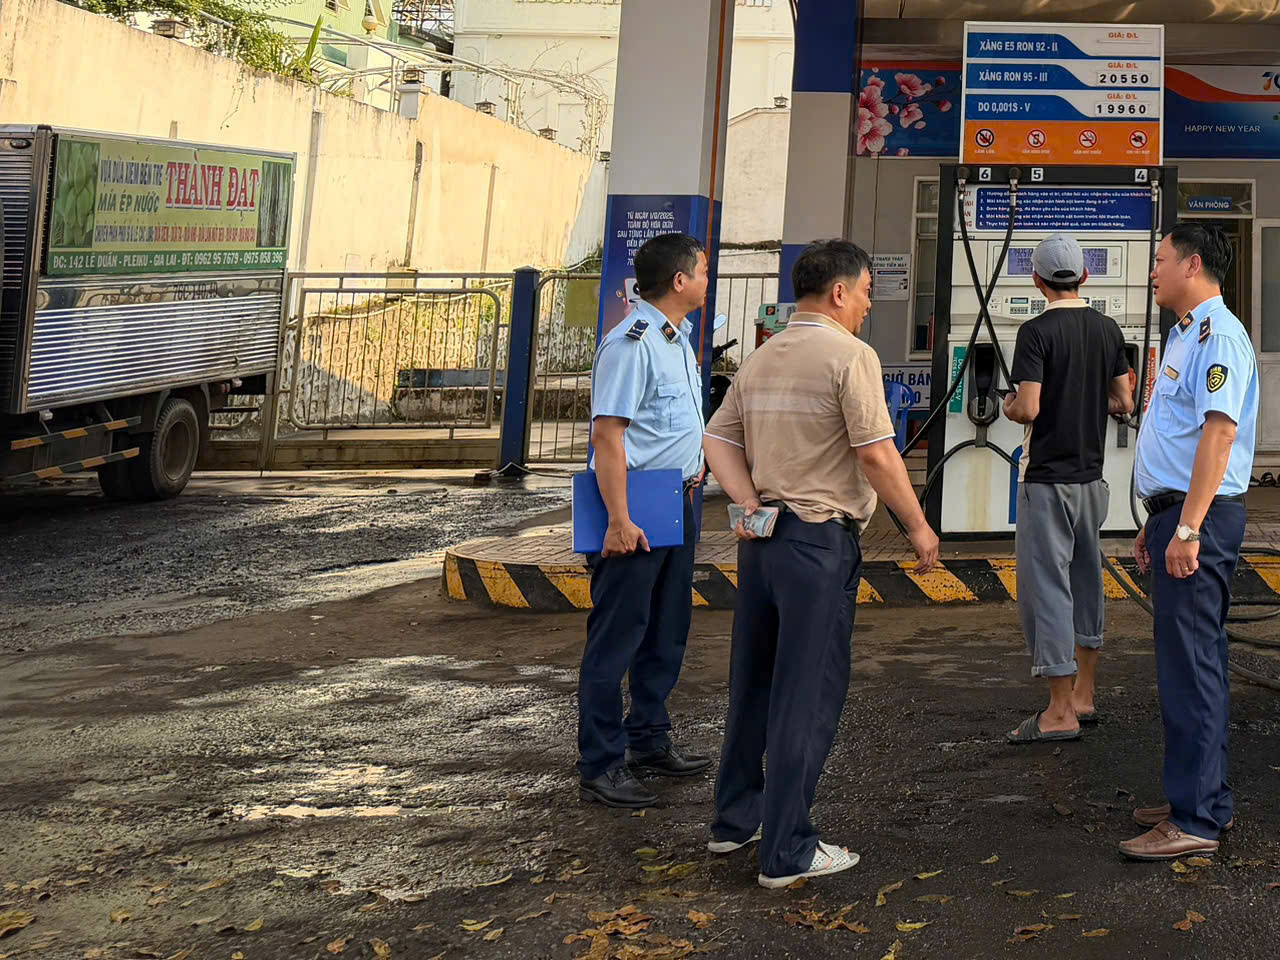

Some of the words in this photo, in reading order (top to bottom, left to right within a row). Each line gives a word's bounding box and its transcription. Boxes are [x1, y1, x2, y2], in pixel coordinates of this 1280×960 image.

[980, 39, 1003, 51] XĂNG
[1005, 41, 1015, 51] E5
[1017, 41, 1034, 52] RON
[1036, 42, 1046, 52] 92
[979, 70, 1002, 82] XĂNG
[1004, 71, 1021, 82] RON
[1023, 72, 1033, 82] 95
[1100, 74, 1149, 84] 20550
[978, 102, 990, 112] DO
[1024, 103, 1031, 113] V
[1097, 105, 1146, 115] 19960
[1185, 125, 1213, 133] HAPPY
[1216, 125, 1236, 133] NEW
[1238, 125, 1261, 133] YEAR
[981, 169, 989, 180] 6
[1033, 170, 1042, 180] 5
[1136, 171, 1145, 181] 4
[166, 151, 224, 210] THÀNH
[227, 168, 260, 221] ĐẠT
[1189, 199, 1203, 208] VĂN
[69, 255, 83, 269] 142
[123, 253, 149, 266] PLEIKU
[153, 253, 165, 266] GIA
[166, 253, 177, 266] LAI
[194, 252, 211, 265] 0962
[213, 252, 222, 265] 95
